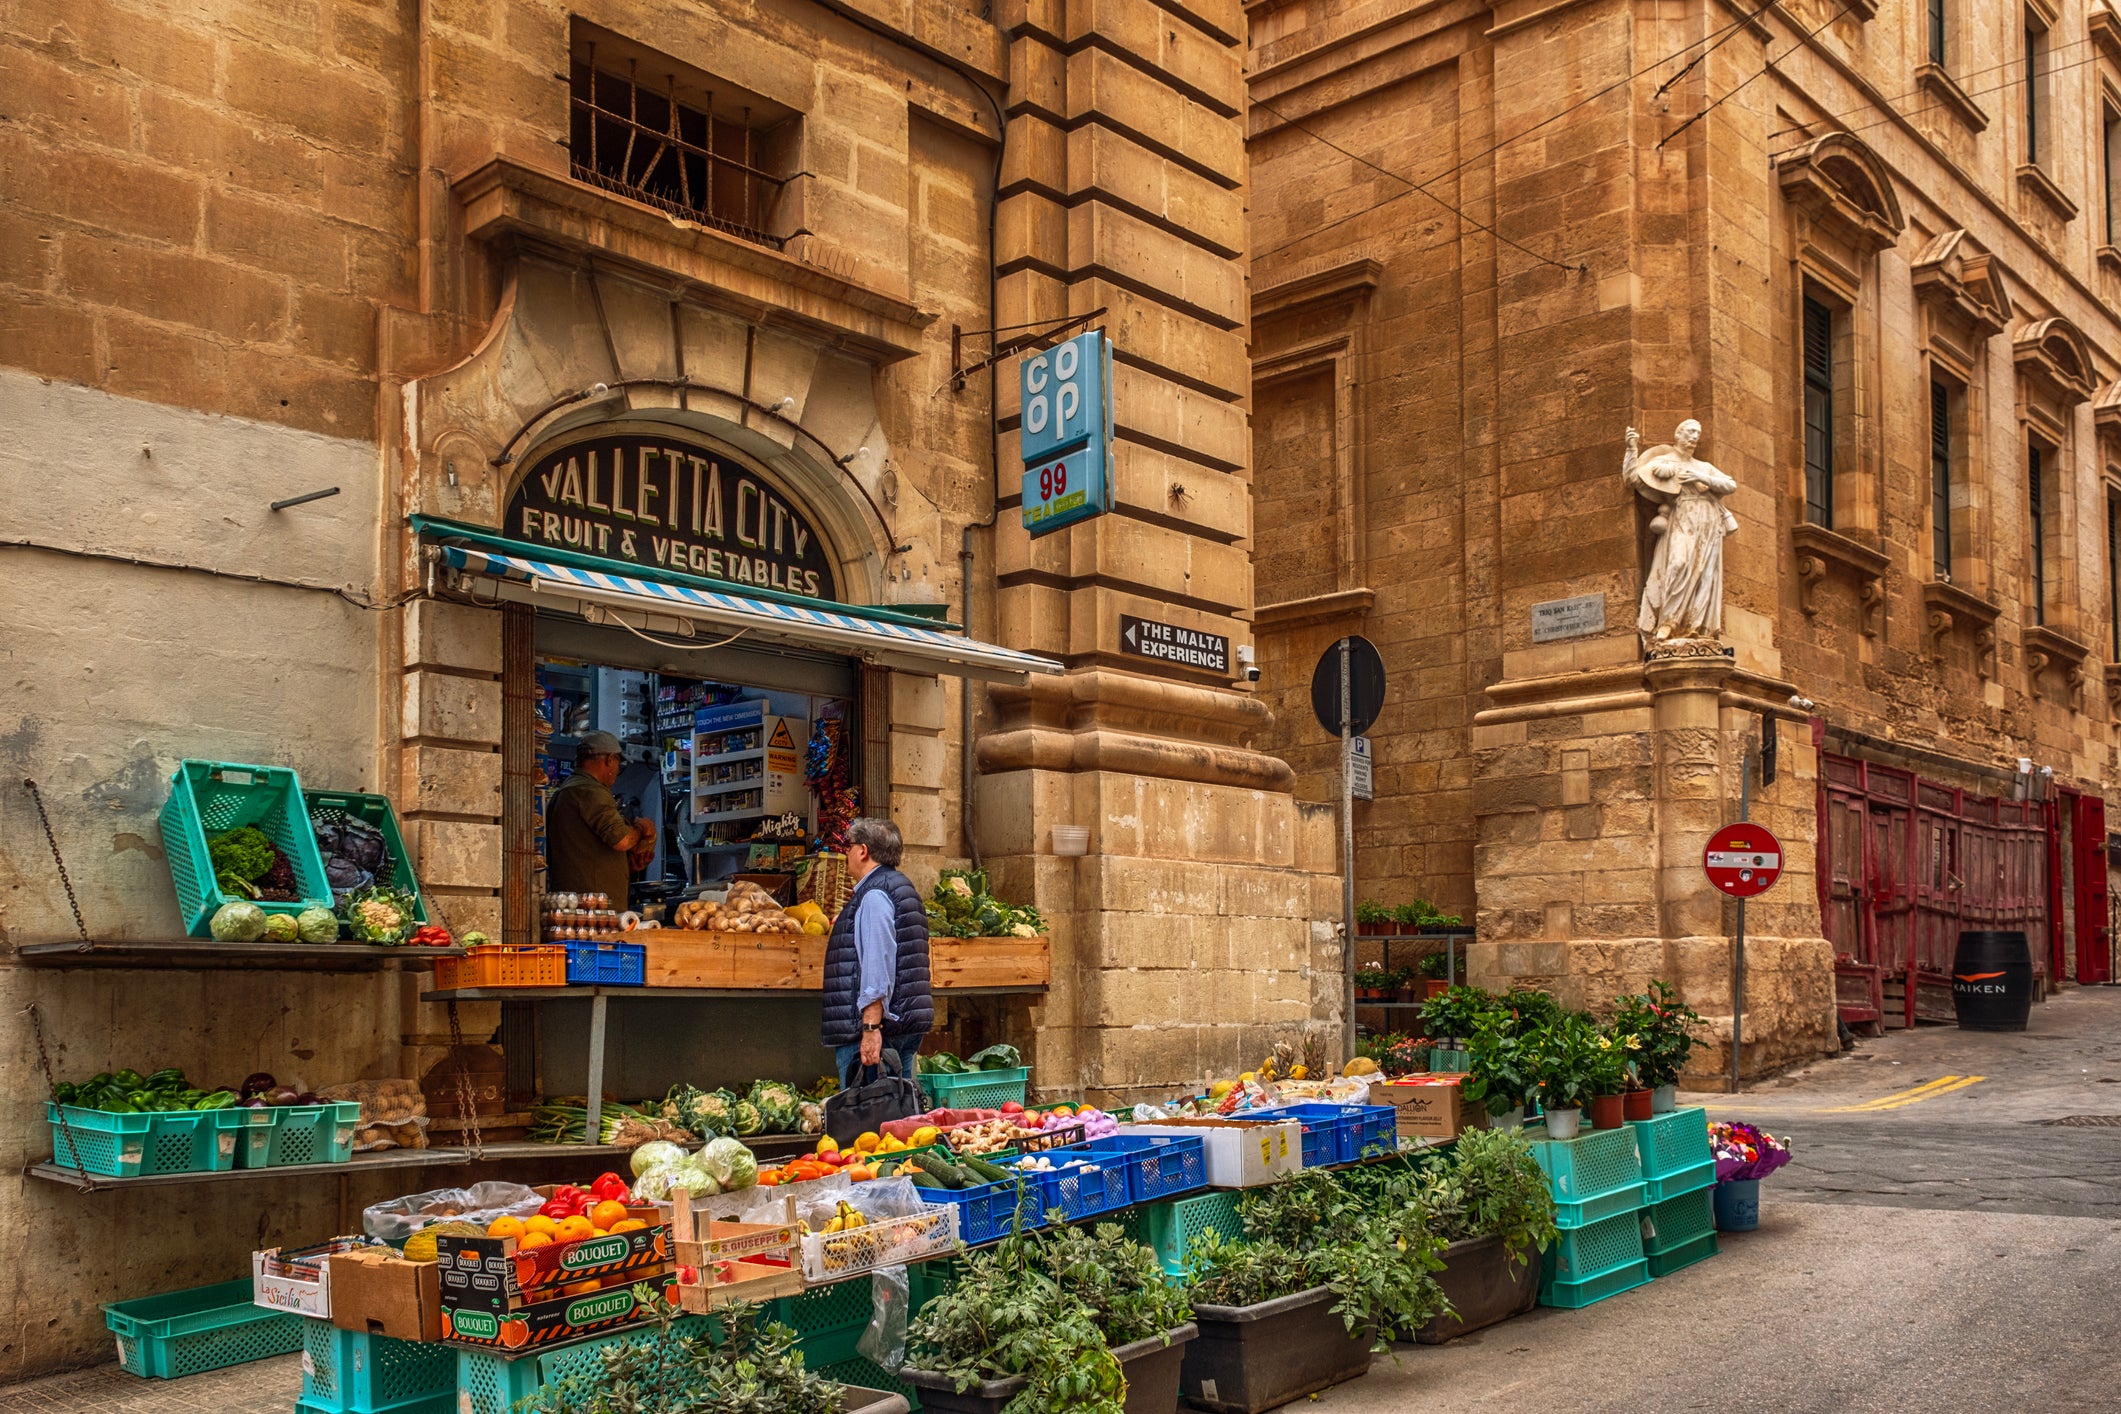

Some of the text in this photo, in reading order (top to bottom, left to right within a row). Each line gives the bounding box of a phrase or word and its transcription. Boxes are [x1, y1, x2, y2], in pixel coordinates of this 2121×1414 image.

[1040, 462, 1067, 501] 99
[541, 446, 808, 560] VALLETTA CITY
[1023, 502, 1053, 525] TEA
[522, 506, 820, 598] FRUIT & VEGETABLES
[1141, 622, 1224, 652] THE MALTA
[1141, 639, 1224, 670] EXPERIENCE
[769, 753, 796, 763] WARNING
[758, 812, 800, 837] Mighty
[459, 1259, 479, 1268] BOUQUET
[567, 1242, 623, 1265] BOUQUET
[447, 1273, 466, 1284] BOUQUET
[475, 1277, 496, 1288] BOUQUET
[261, 1283, 301, 1309] La Sicilia
[573, 1296, 629, 1320] BOUQUET
[457, 1315, 493, 1332] BOUQUET
